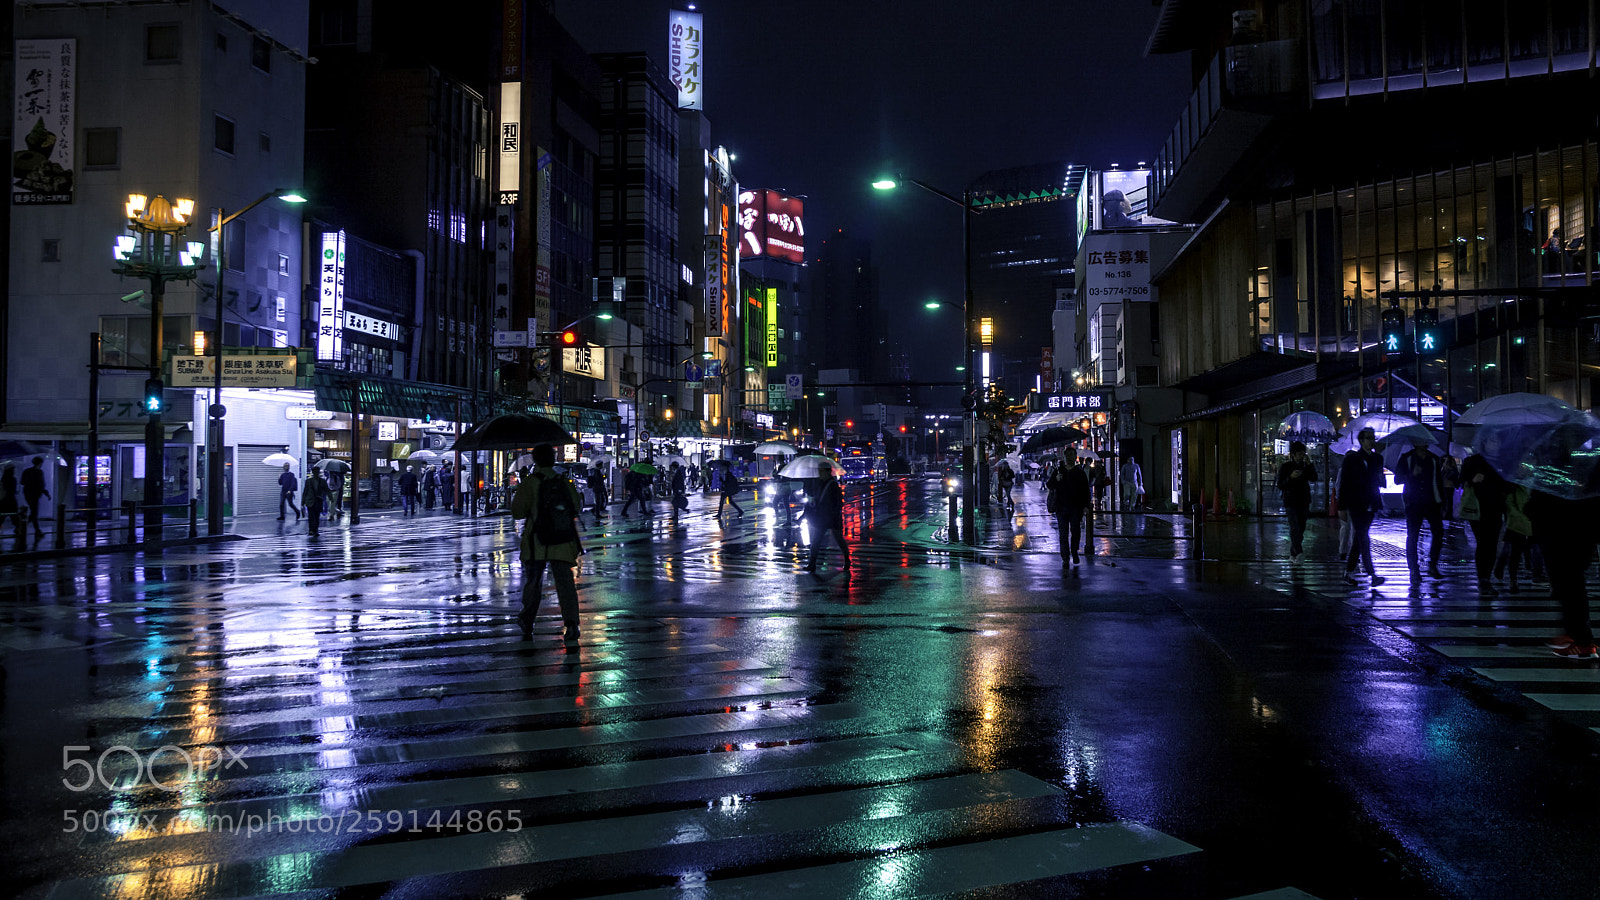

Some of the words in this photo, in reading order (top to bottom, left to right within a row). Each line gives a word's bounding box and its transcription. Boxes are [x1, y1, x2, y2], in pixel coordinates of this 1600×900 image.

[685, 26, 700, 93] カラオケ
[504, 124, 517, 151] 和民
[768, 214, 804, 236] つぼ八
[708, 240, 718, 284] カラオケ
[1088, 250, 1148, 265] 広告募集
[1089, 287, 1148, 296] 03-5774-7506
[710, 287, 718, 331] SHIDAX
[177, 360, 204, 368] 地下鉄
[225, 360, 253, 368] 銀座線
[256, 360, 284, 368] 浅草駅
[1048, 396, 1101, 408] 雷門東部
